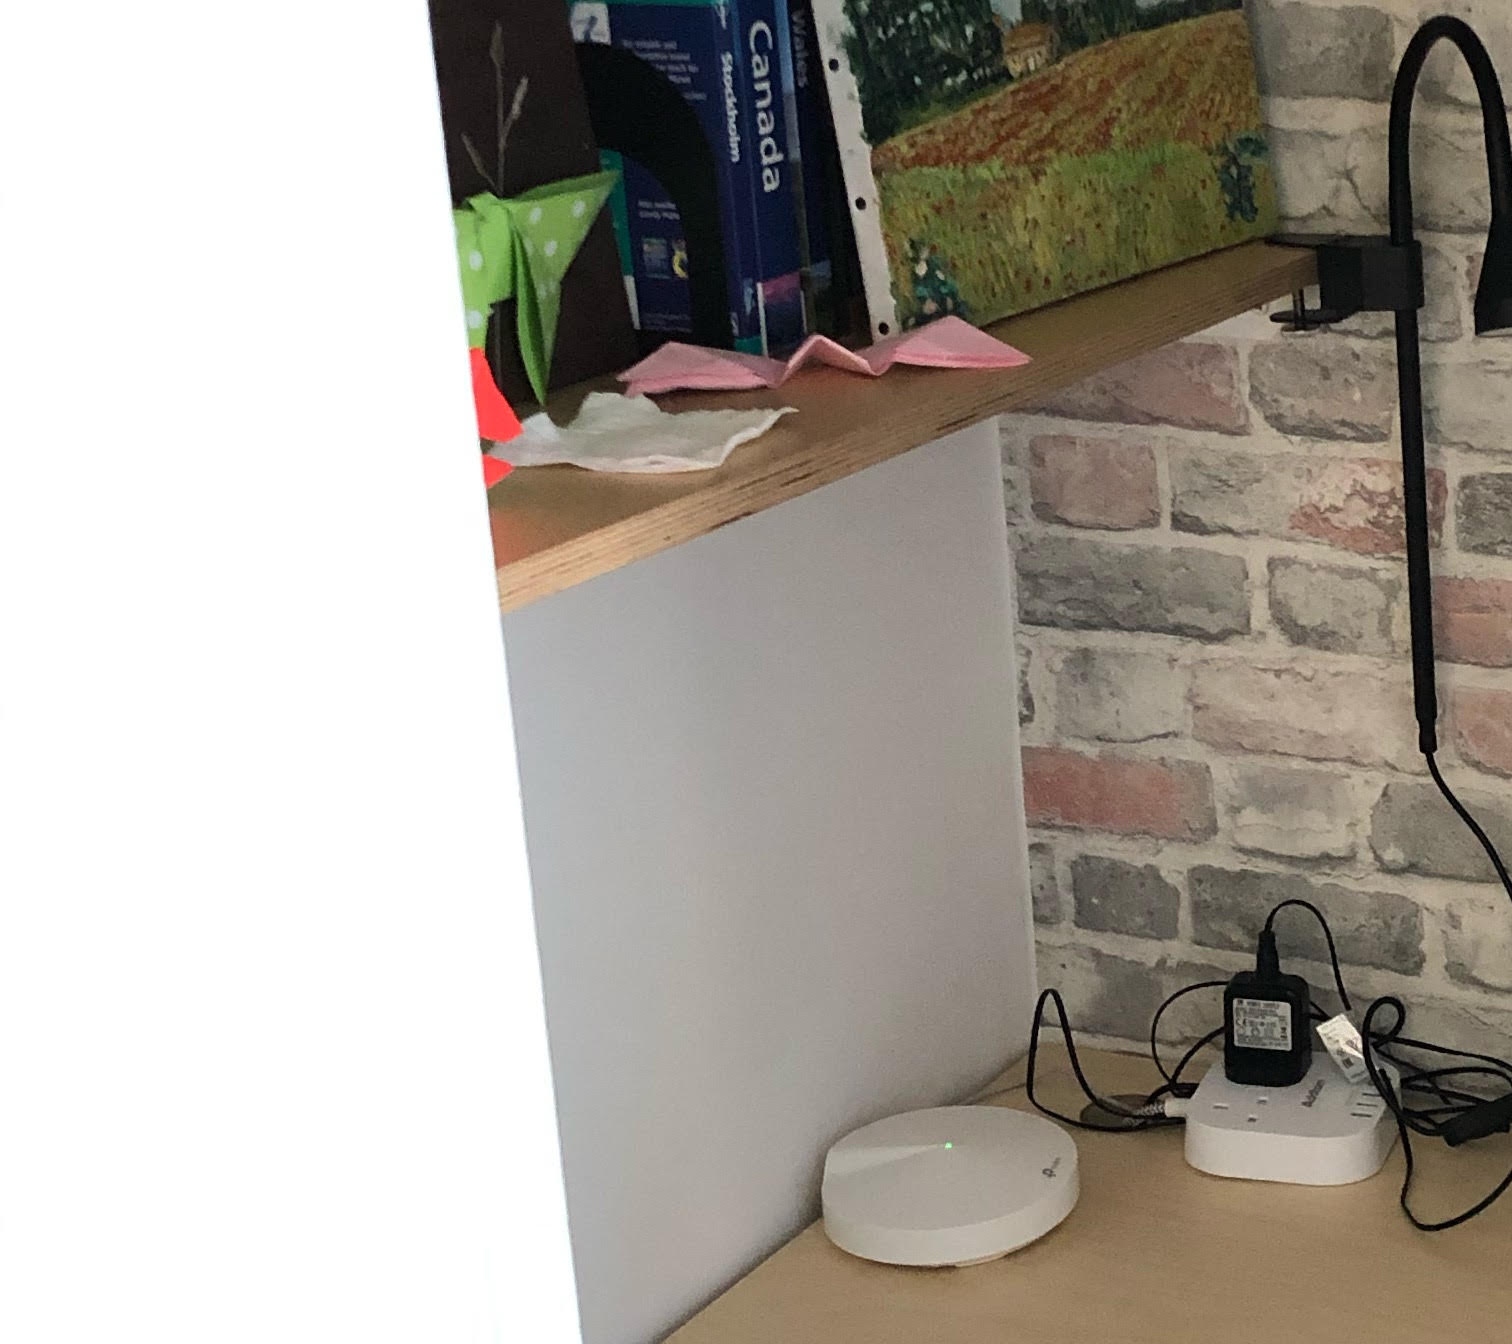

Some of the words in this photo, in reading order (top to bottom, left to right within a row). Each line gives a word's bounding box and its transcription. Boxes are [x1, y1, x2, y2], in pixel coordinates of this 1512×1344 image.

[791, 10, 810, 87] Wales
[719, 52, 742, 162] Stockholm
[748, 20, 785, 193] Canada
